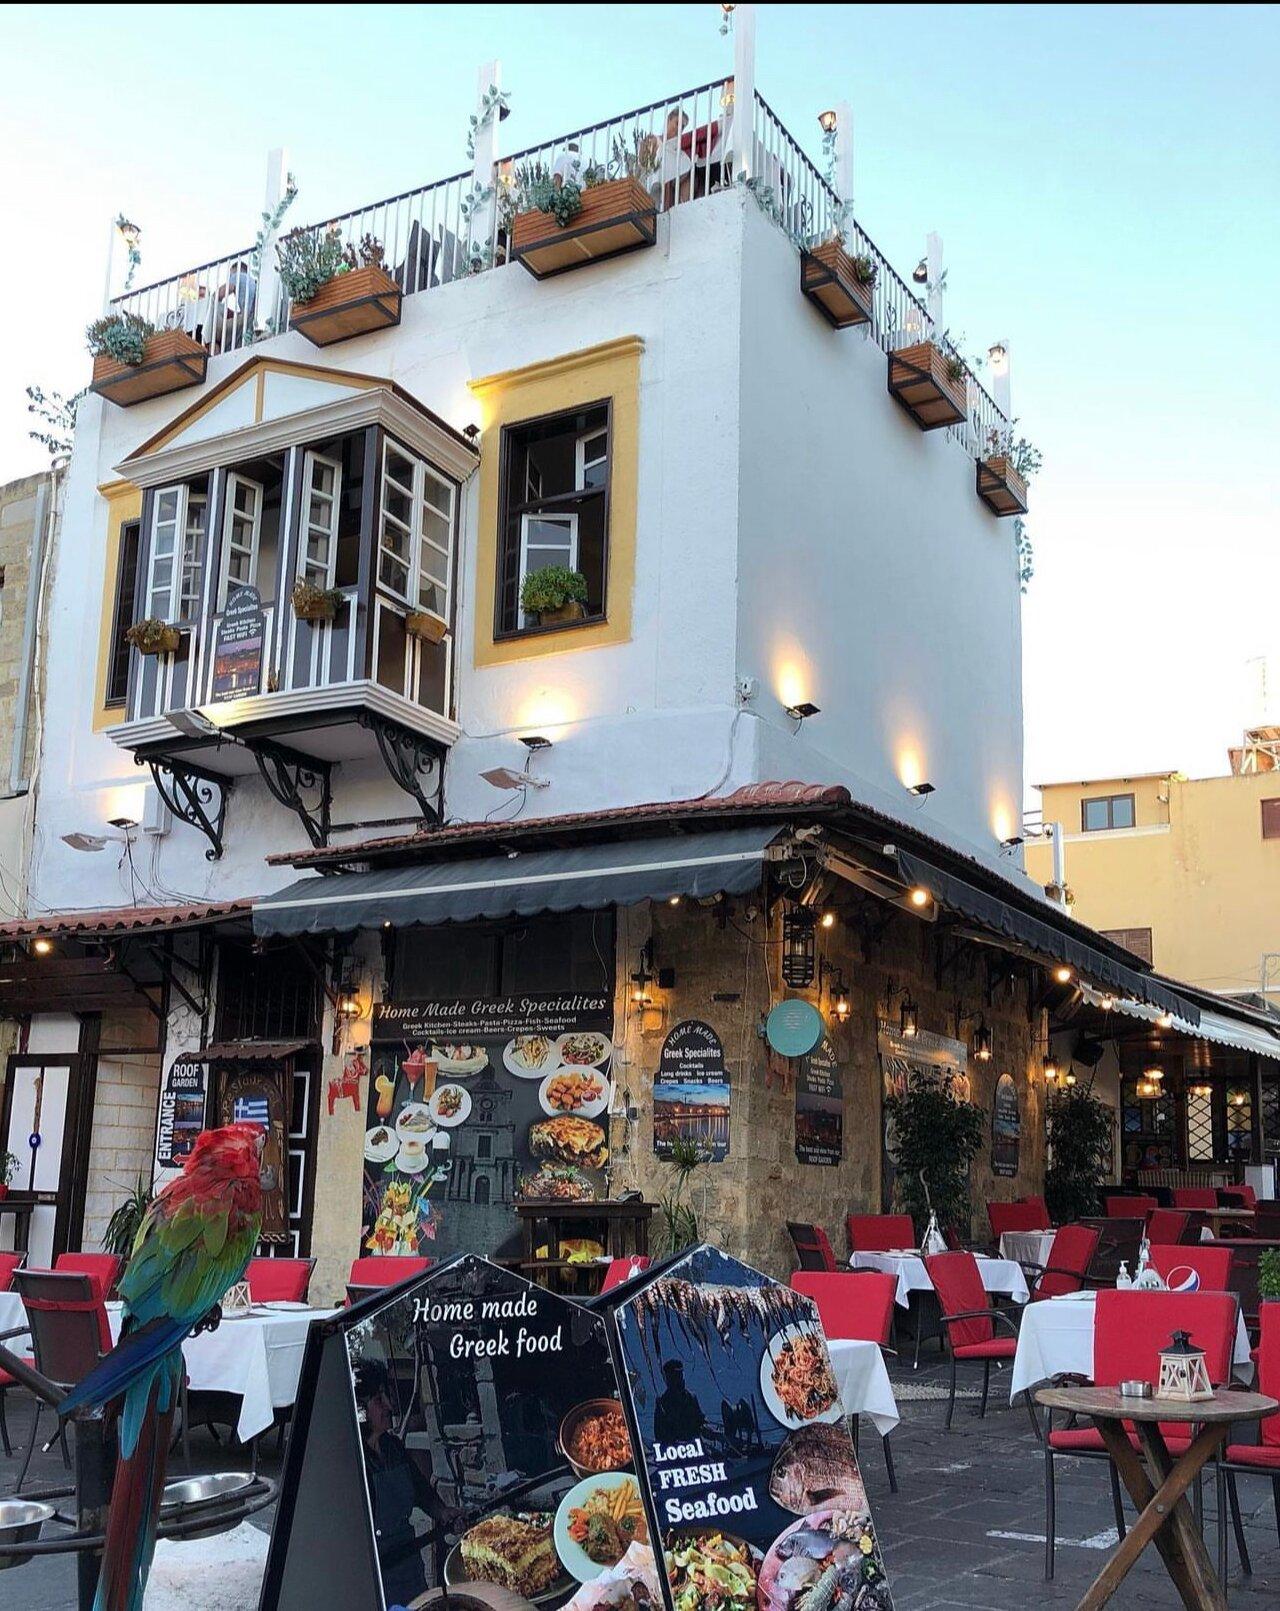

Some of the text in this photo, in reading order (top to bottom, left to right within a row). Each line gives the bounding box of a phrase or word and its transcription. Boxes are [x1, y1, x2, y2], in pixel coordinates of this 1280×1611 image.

[379, 995, 607, 1019] Home Made Greek Specialites
[668, 1025, 717, 1046] HOME MADE
[664, 1047, 721, 1060] Greek Specialites
[172, 1063, 200, 1087] ROOF GARDEN
[661, 1070, 674, 1078] Long
[158, 1092, 176, 1160] ENTRANCE
[412, 1291, 538, 1323] Home made
[450, 1325, 563, 1358] Greek food
[653, 1438, 704, 1462] Local
[658, 1462, 728, 1489] FRESH
[665, 1487, 758, 1523] Seafood
